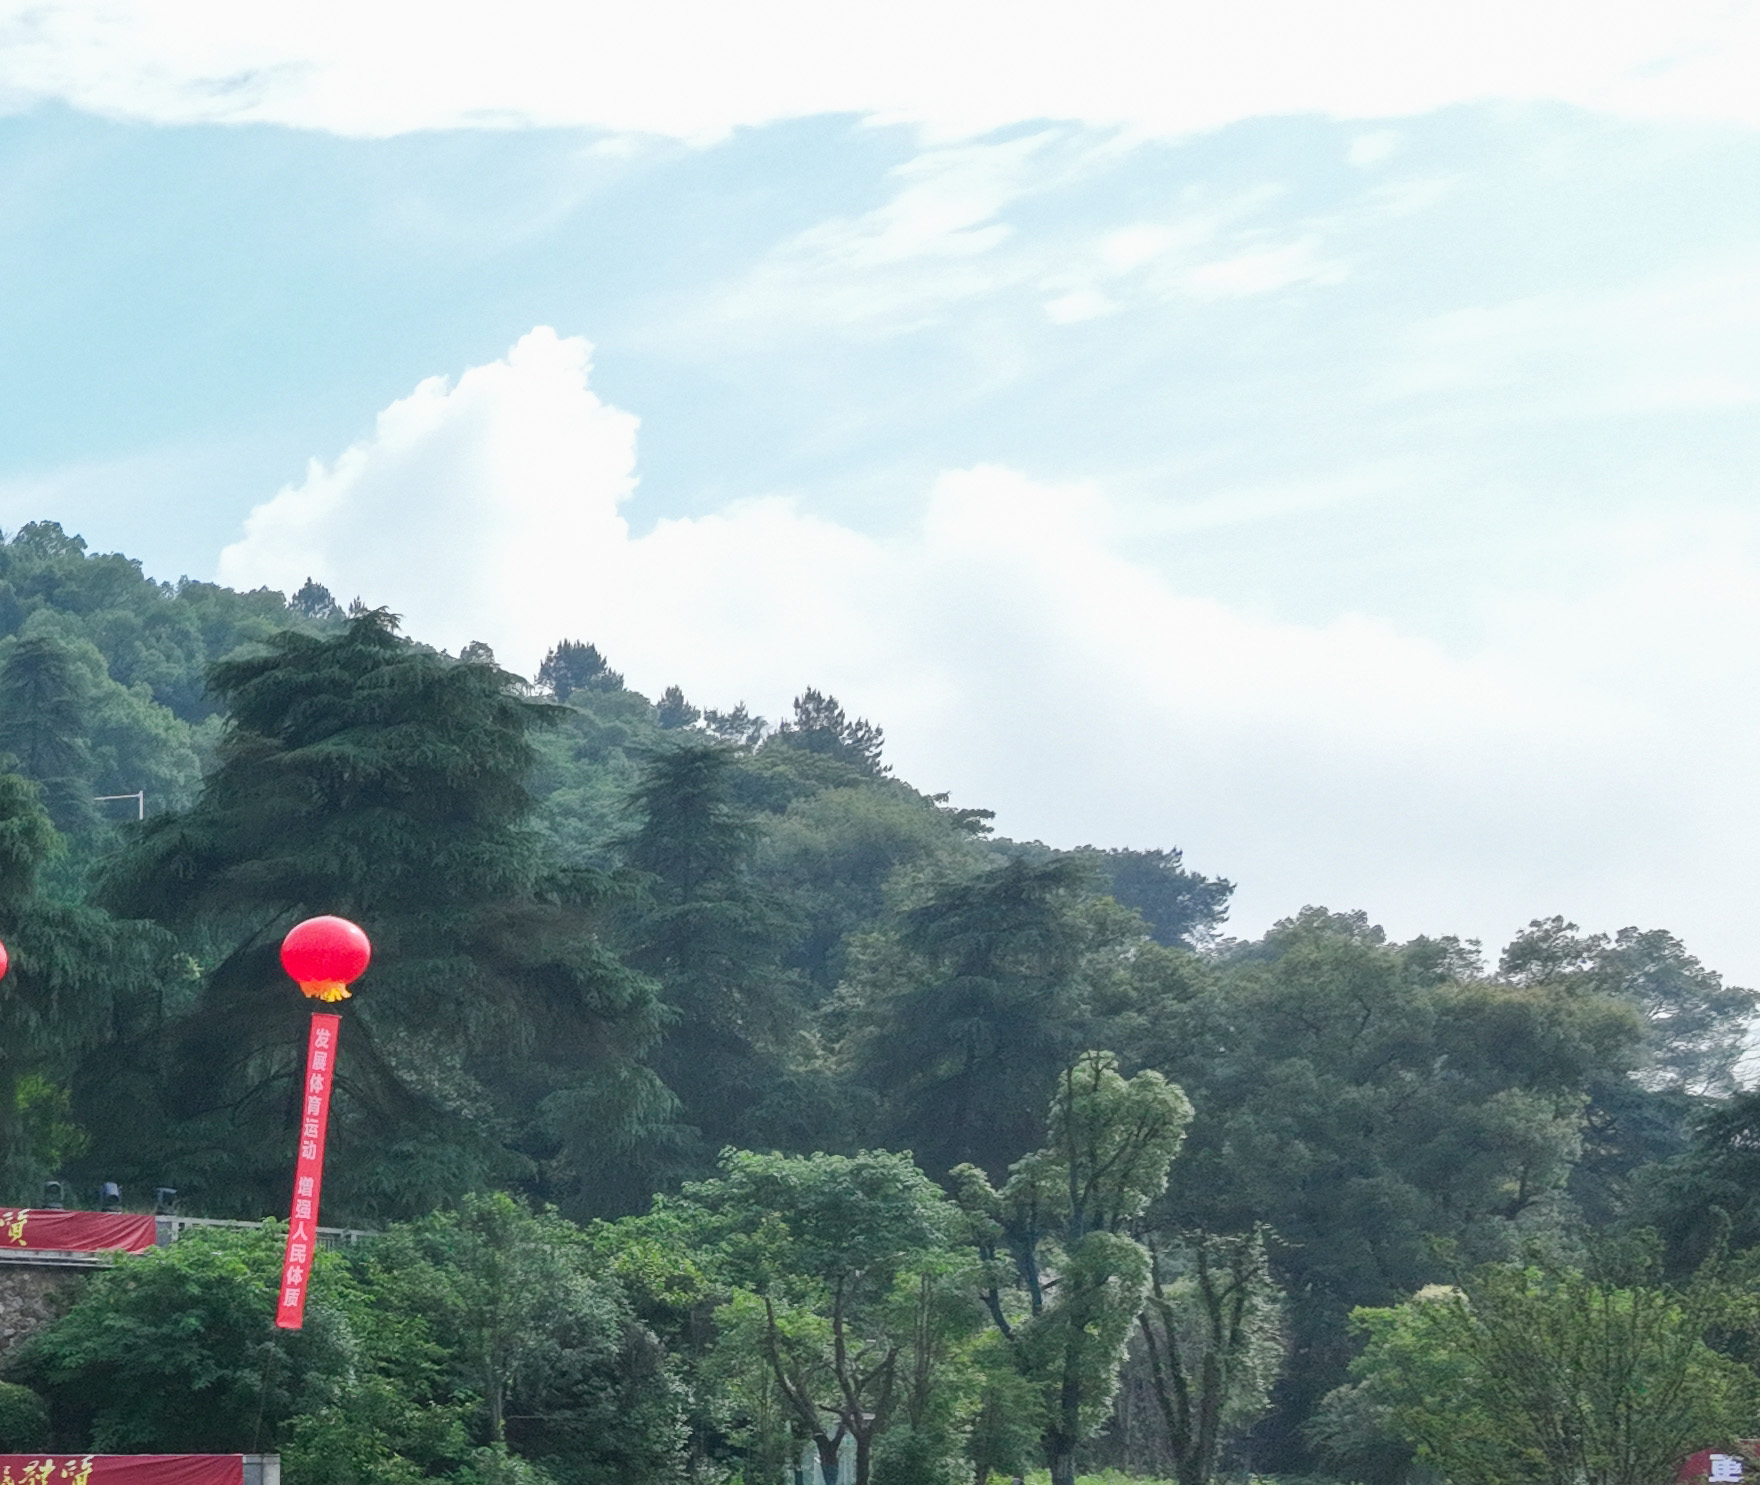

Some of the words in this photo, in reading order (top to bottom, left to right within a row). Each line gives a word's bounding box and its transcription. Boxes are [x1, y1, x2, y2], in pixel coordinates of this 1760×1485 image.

[302, 1028, 331, 1160] 发展体育运动
[283, 1177, 314, 1307] 增强人民体质
